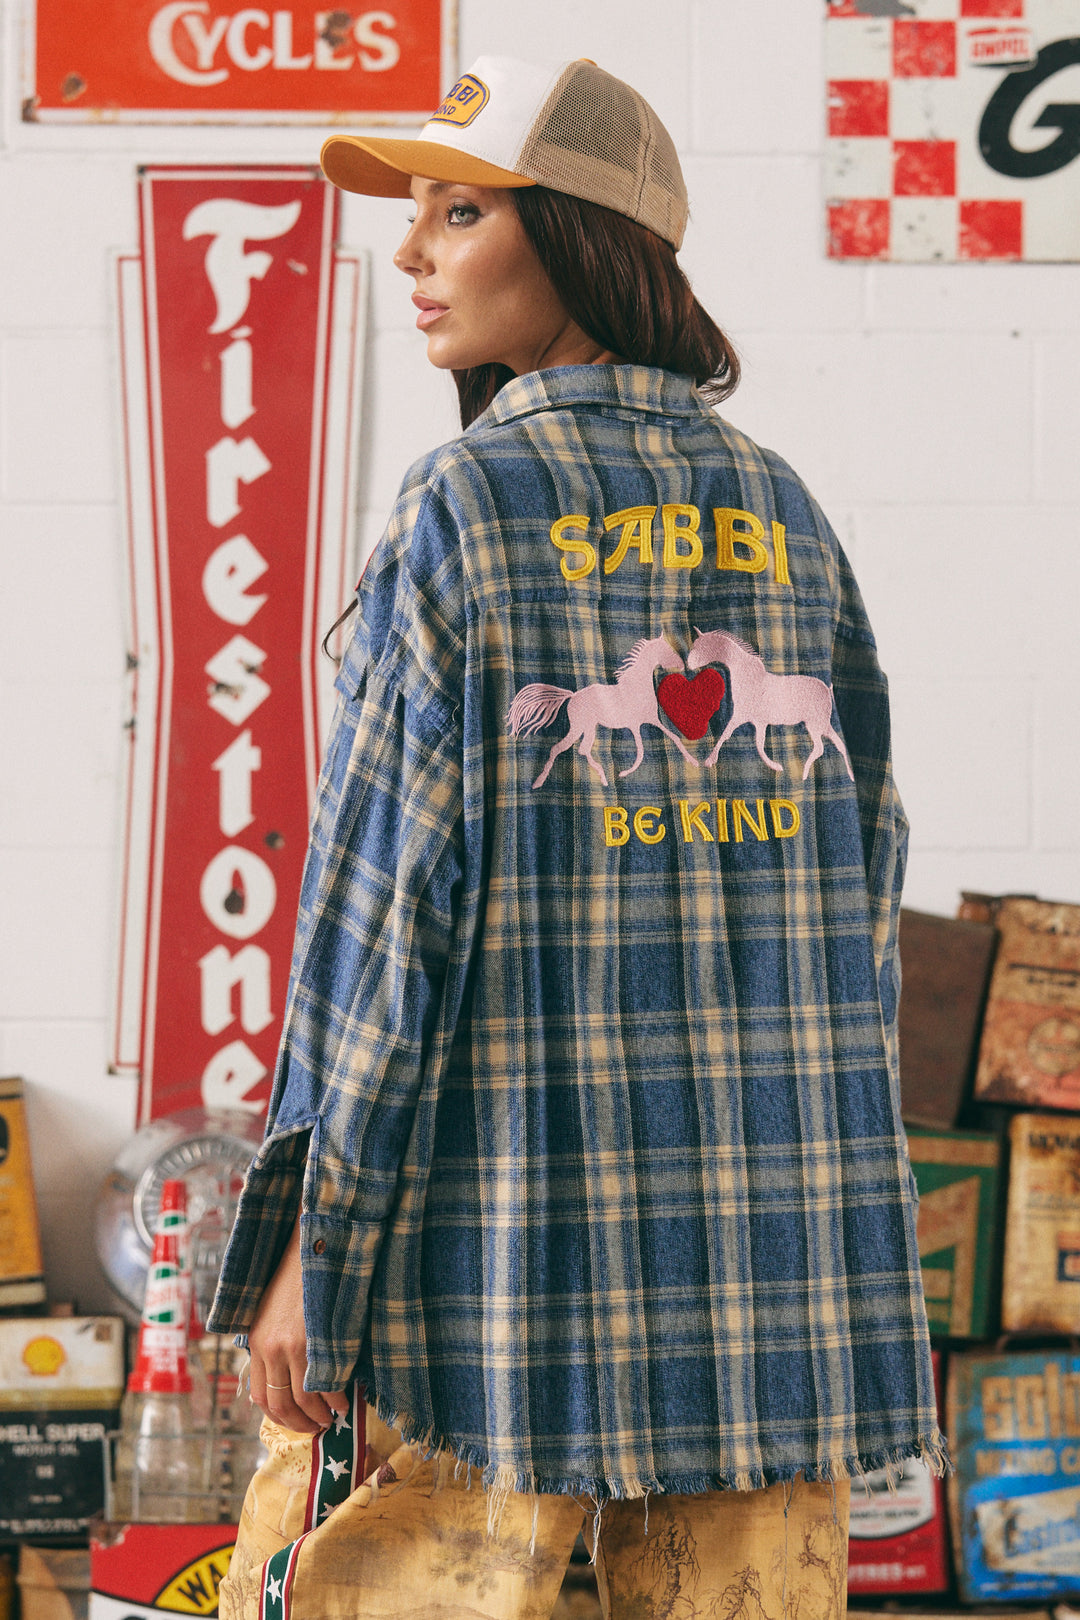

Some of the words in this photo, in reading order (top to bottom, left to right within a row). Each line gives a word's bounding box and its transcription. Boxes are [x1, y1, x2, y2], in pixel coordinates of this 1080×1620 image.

[148, 1, 400, 86] CYCLES
[550, 503, 791, 584] SABBI
[183, 198, 302, 1112] Firestone
[604, 806, 666, 846] BE
[679, 799, 800, 843] KIND
[46, 1423, 104, 1442] SUPER
[178, 1555, 232, 1607] WA
